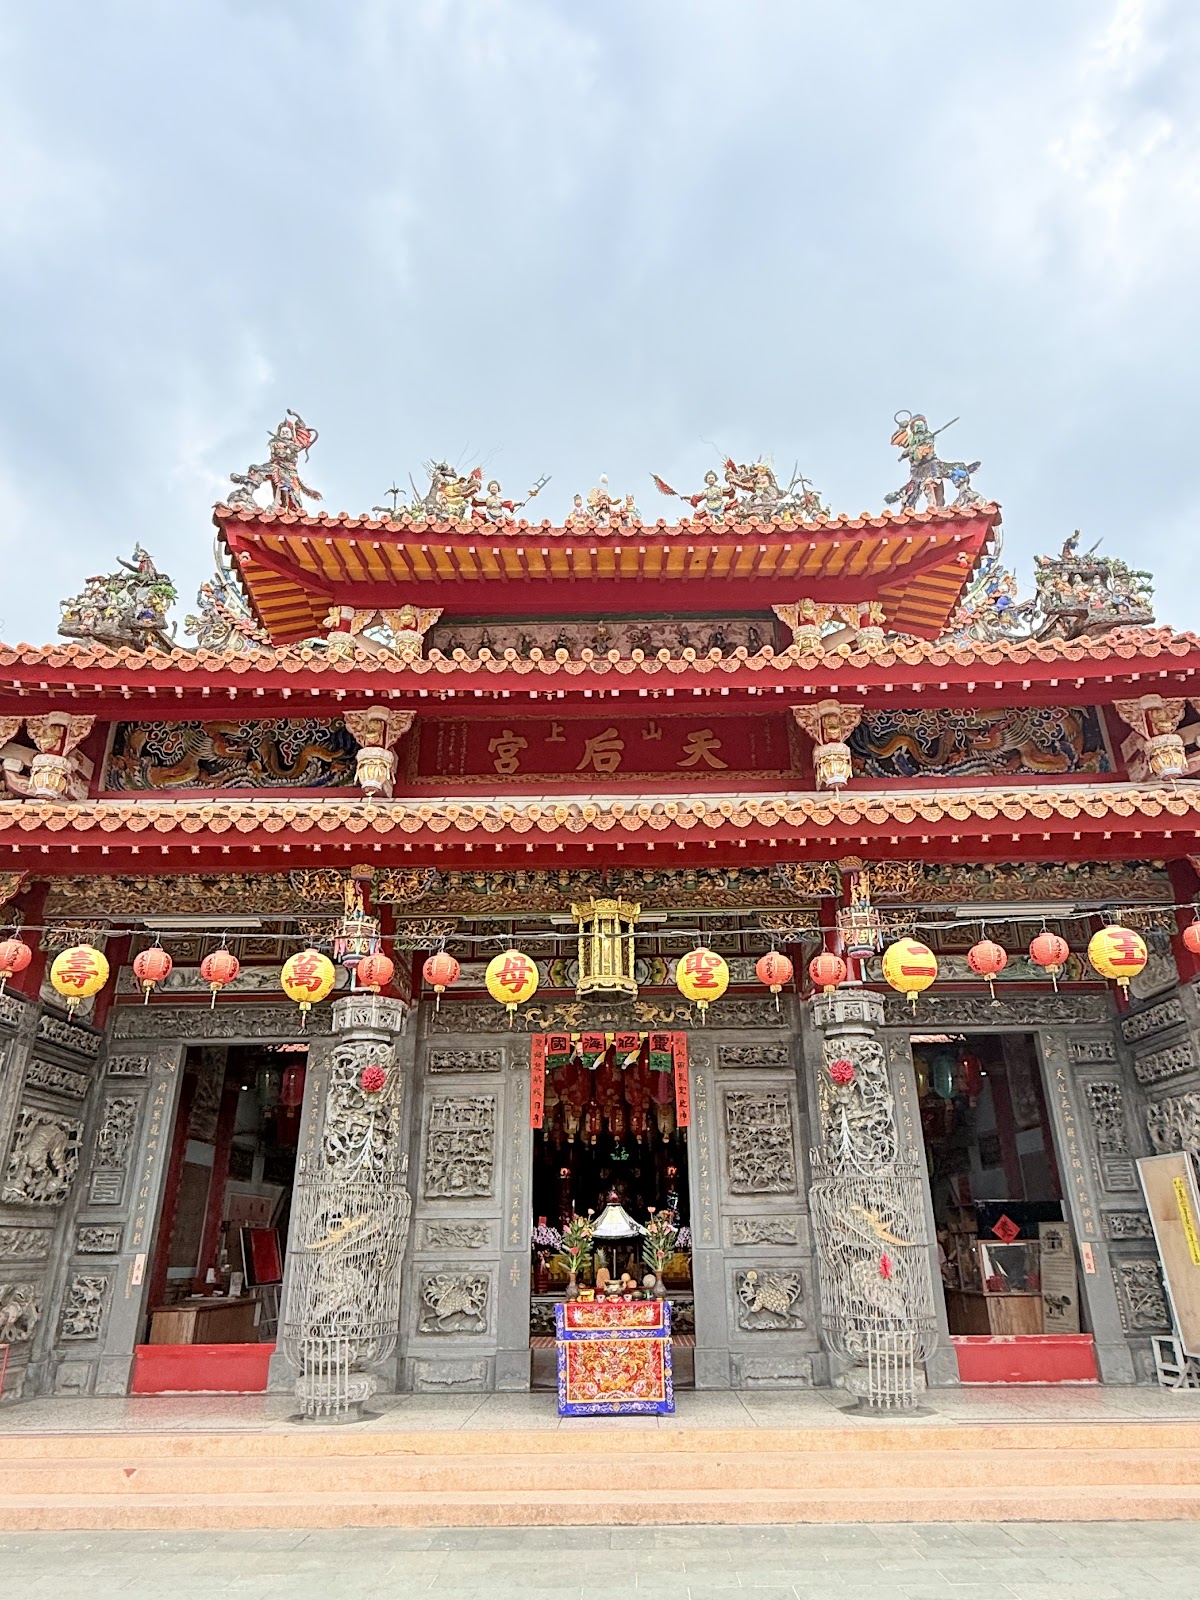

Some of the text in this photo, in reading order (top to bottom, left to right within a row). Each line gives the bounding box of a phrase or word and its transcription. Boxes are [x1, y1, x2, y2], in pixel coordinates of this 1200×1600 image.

[57, 950, 99, 988] 壽
[286, 954, 323, 992] 萬
[496, 956, 533, 994] 母
[685, 952, 722, 988] 聖
